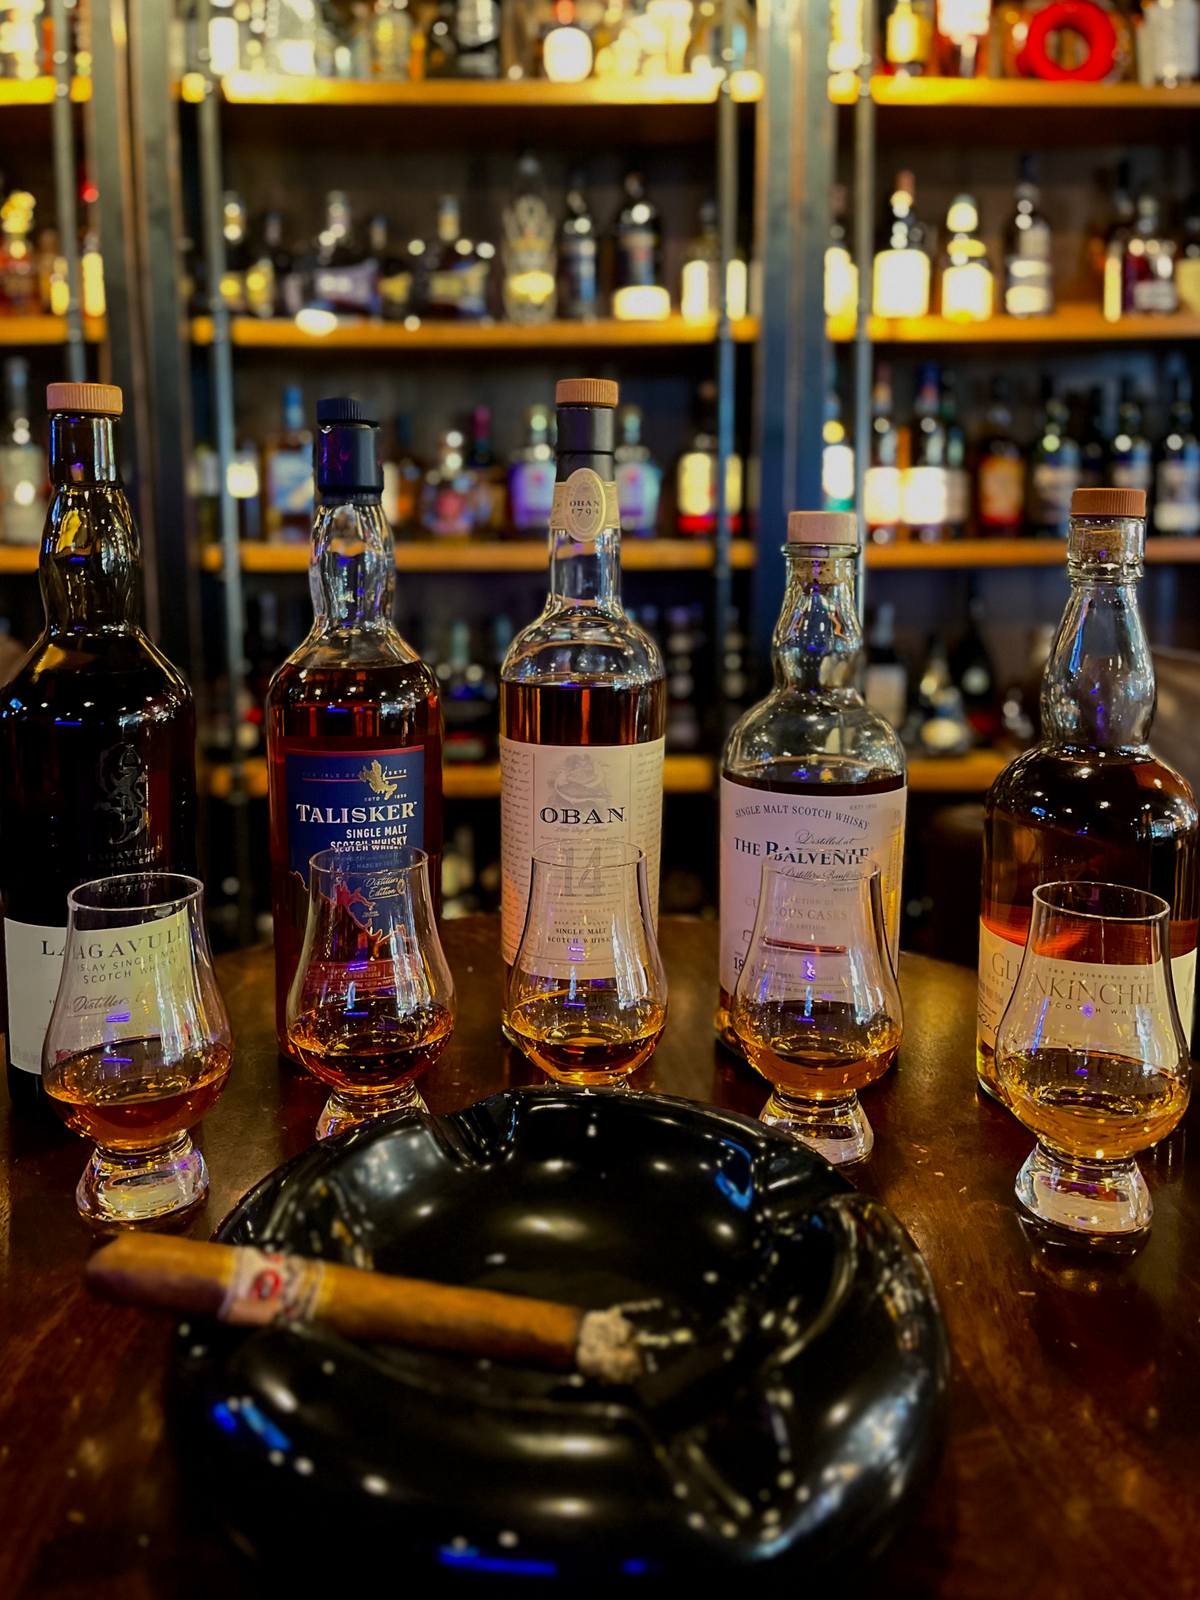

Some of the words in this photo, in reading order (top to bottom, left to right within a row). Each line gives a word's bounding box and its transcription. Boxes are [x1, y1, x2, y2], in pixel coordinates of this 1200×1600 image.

[295, 801, 416, 824] TALISKER
[540, 806, 626, 825] OBAN
[735, 805, 761, 819] SINGLE
[763, 804, 789, 814] MALT
[791, 805, 832, 819] SCOTCH
[835, 812, 870, 831] WHISKY
[346, 828, 382, 839] SINGLE
[384, 823, 408, 836] MALT
[795, 829, 841, 845] Distilled
[330, 841, 369, 853] SCOTCH
[371, 835, 408, 851] WHISKY
[734, 837, 760, 856] THE
[766, 841, 870, 865] BALVENIE
[368, 886, 397, 898] Edition
[807, 909, 847, 920] CASKS
[587, 927, 607, 935] MALT
[547, 936, 579, 944] SCOTCH
[584, 936, 614, 944] WHISK
[112, 954, 154, 970] SINGLE
[83, 971, 132, 984] SCOTCH
[1072, 971, 1127, 980] EDINBURGH
[73, 994, 130, 1013] Distillers
[1048, 1000, 1102, 1014] SCOTH
